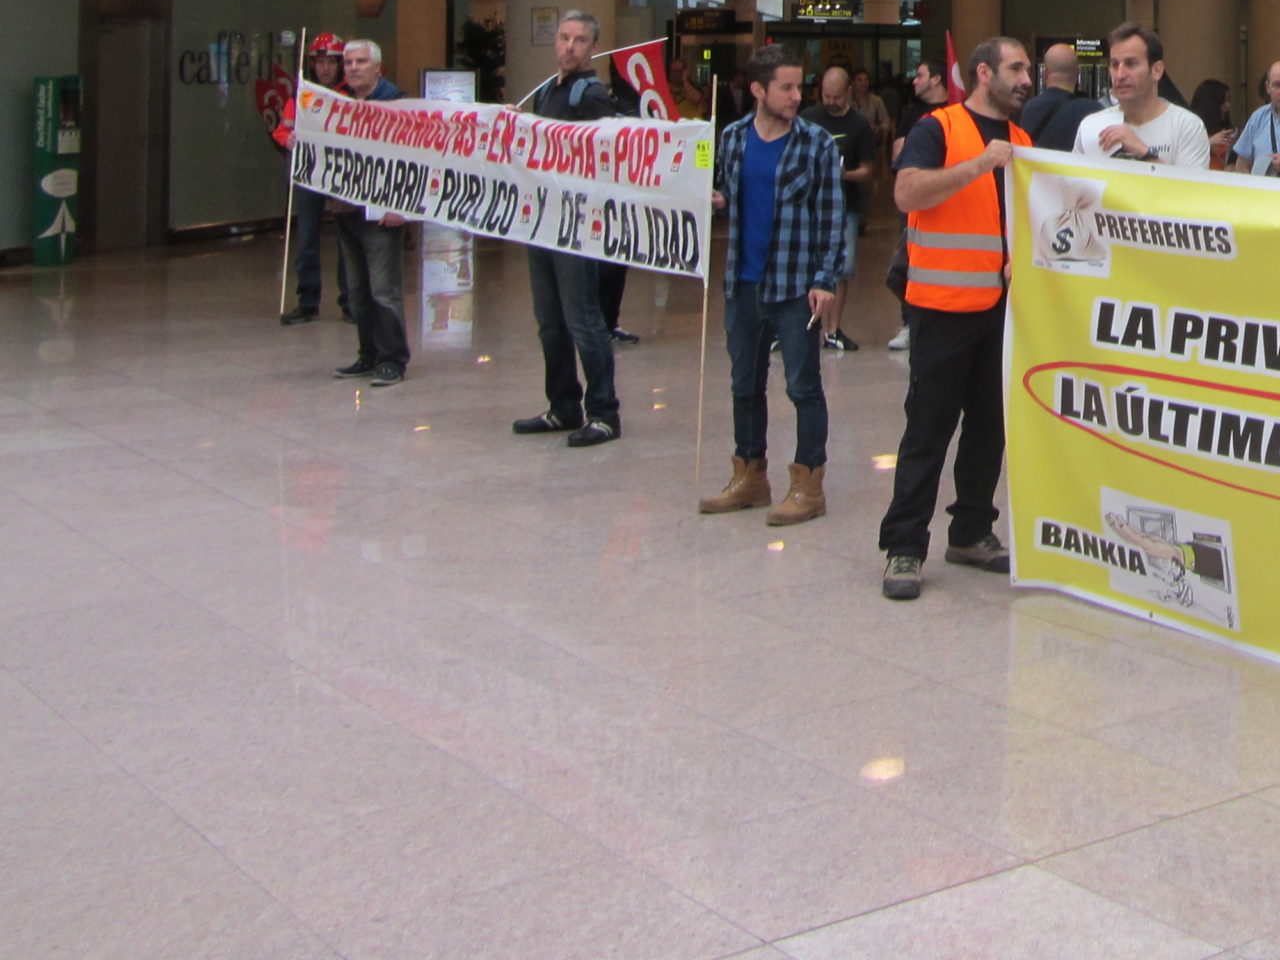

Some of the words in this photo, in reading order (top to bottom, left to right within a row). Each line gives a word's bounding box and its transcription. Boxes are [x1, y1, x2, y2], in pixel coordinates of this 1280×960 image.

[486, 111, 519, 164] EN
[526, 120, 600, 180] LUCHA
[293, 141, 317, 186] UN
[321, 146, 429, 215] FERROCARRIL
[433, 168, 519, 237] PUBLICO
[530, 186, 548, 241] Y
[557, 190, 588, 250] DE
[602, 199, 700, 272] CALIDAD
[1094, 212, 1232, 254] PREFERENTES
[1096, 302, 1156, 351] LA
[1059, 377, 1108, 428] LA
[1041, 521, 1148, 576] BANKIA
